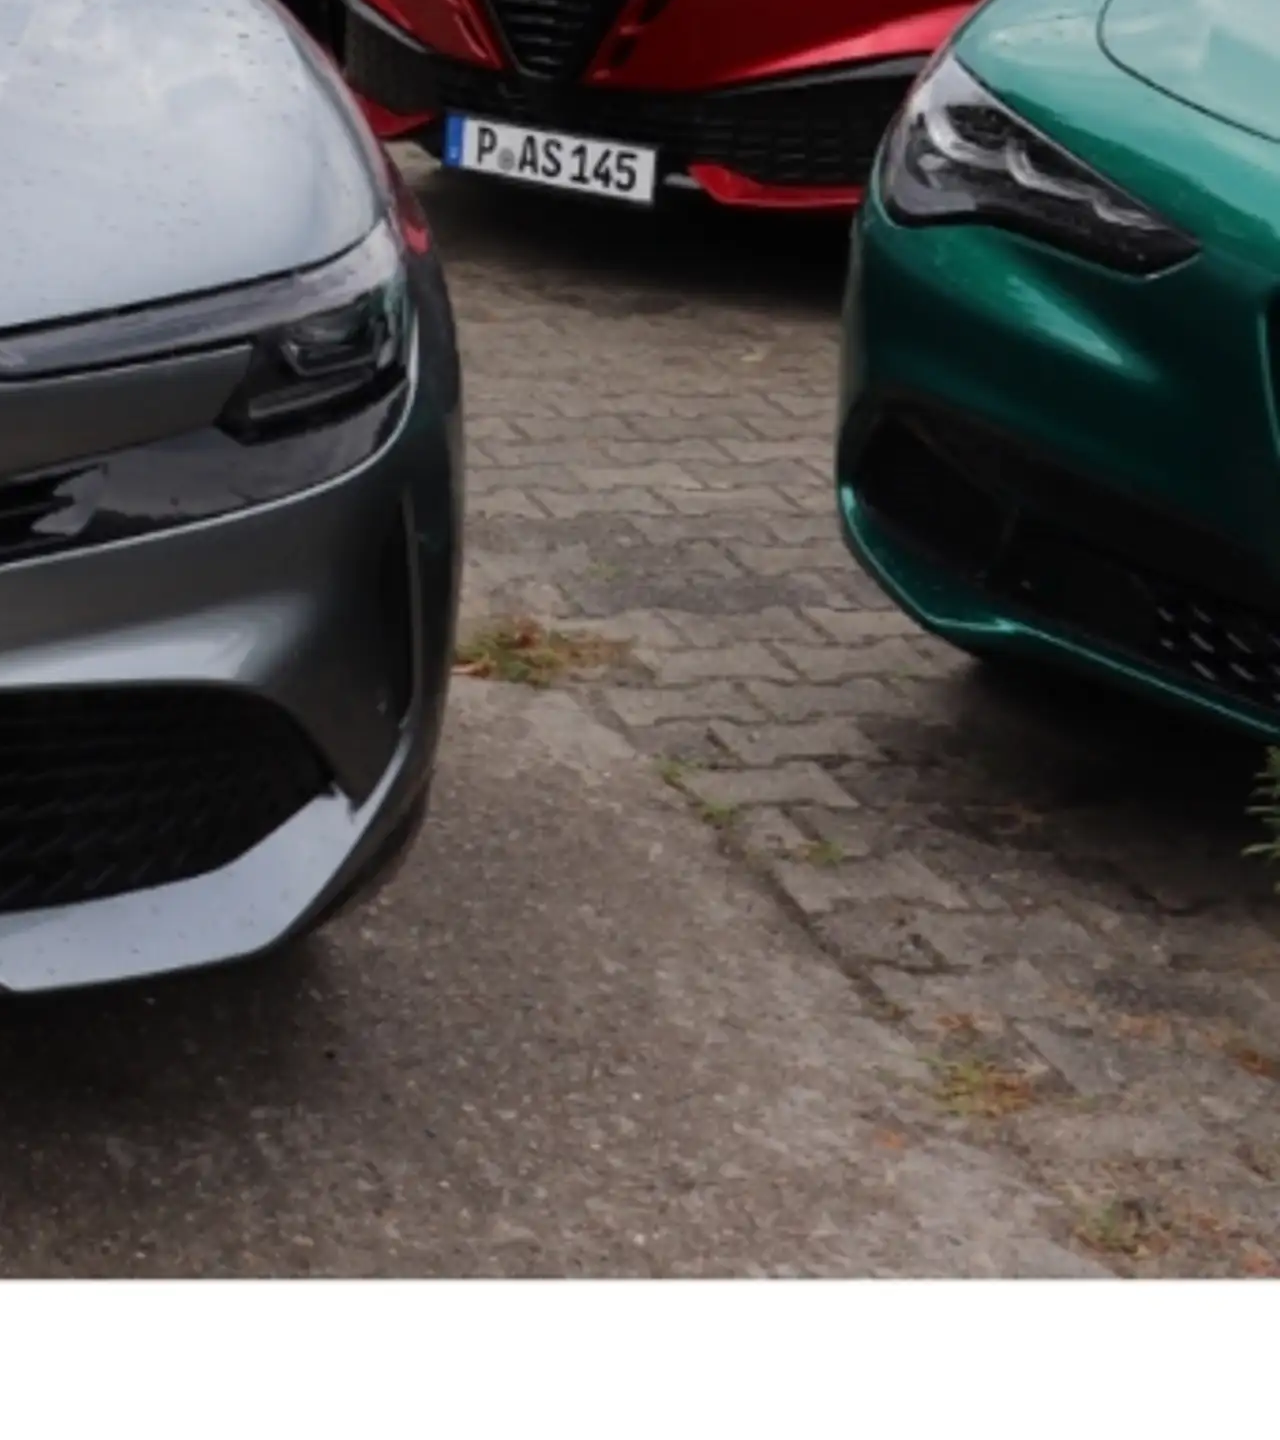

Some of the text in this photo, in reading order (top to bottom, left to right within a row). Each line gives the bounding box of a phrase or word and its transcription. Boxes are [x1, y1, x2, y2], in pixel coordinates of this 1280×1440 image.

[476, 125, 638, 193] P AS 145
